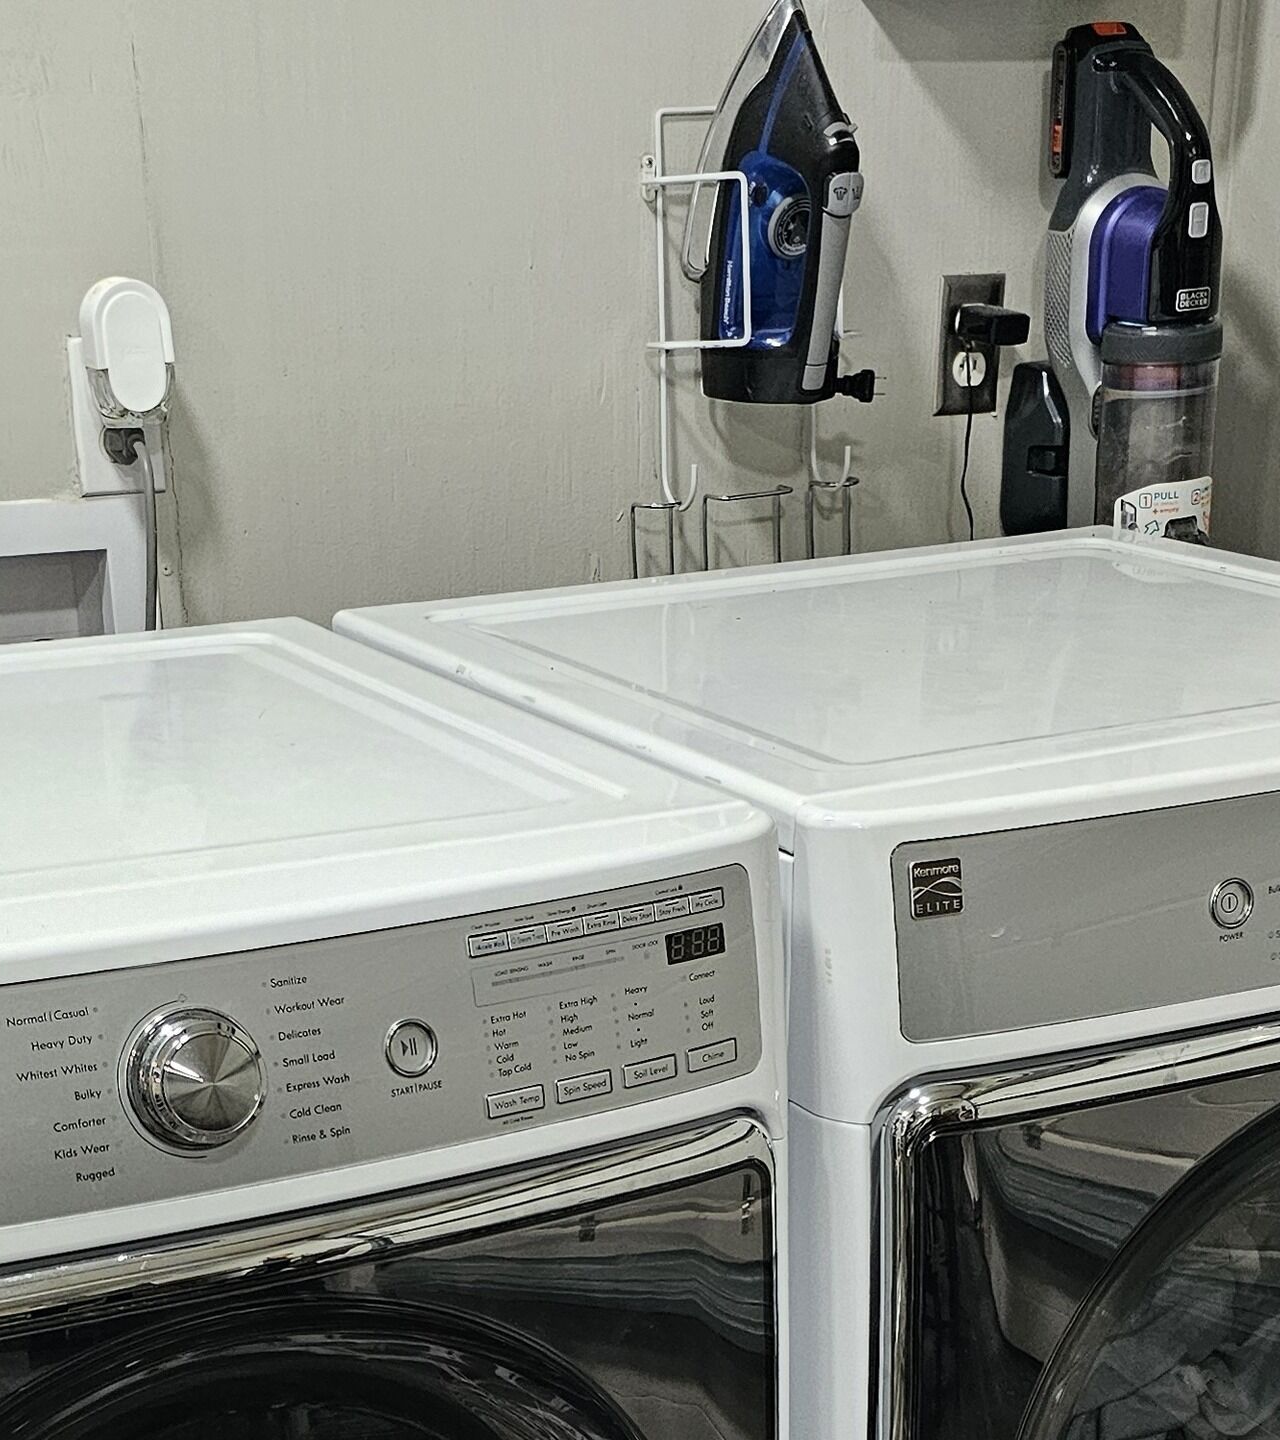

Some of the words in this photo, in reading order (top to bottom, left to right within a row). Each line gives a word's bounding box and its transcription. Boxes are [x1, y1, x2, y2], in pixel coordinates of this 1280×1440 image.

[1179, 298, 1207, 308] DECKER
[1153, 491, 1179, 501] PULL
[913, 865, 959, 878] Kenmore
[915, 899, 960, 914] ELITE
[563, 925, 580, 935] Wash
[1219, 931, 1244, 943] POWER
[269, 975, 309, 989] Sanitize
[688, 970, 716, 982] Connect
[624, 985, 648, 996] Heavy
[274, 1000, 317, 1015] Workout
[317, 996, 346, 1008] Wear
[559, 1000, 579, 1010] Extra
[580, 994, 598, 1006] High
[698, 994, 715, 1006] Loud
[490, 1014, 511, 1024] Extra
[512, 1010, 526, 1020] Hot
[560, 1013, 579, 1024] High
[627, 1008, 655, 1021] Normal
[700, 1008, 714, 1019] Soft
[562, 1024, 593, 1036] Medium
[701, 1021, 714, 1031] Off
[278, 1026, 323, 1042] Delicates
[492, 1028, 506, 1038] Hot
[31, 1039, 66, 1052] Heavy
[68, 1035, 94, 1046] Duty
[494, 1040, 520, 1051] Warm
[563, 1041, 578, 1050] Low
[630, 1037, 648, 1048] Light
[282, 1055, 311, 1069] Small
[312, 1050, 337, 1063] Load
[496, 1053, 514, 1064] Cold
[565, 1053, 577, 1062] No
[578, 1049, 595, 1060] Spin
[701, 1051, 725, 1062] Chime
[15, 1068, 59, 1083] Whitest
[61, 1062, 99, 1076] Whites
[514, 1062, 532, 1073] Cold
[633, 1070, 648, 1080] Soil
[649, 1064, 669, 1076] Level
[286, 1080, 322, 1094] Express
[322, 1073, 351, 1087] Wash
[563, 1085, 581, 1096] Spin
[582, 1078, 608, 1092] Speed
[74, 1089, 103, 1102] Bulky
[494, 1100, 517, 1110] Wash
[519, 1094, 540, 1105] Temp
[289, 1105, 312, 1120] Cold
[313, 1102, 343, 1116] Clean
[53, 1117, 108, 1134] Comforter
[291, 1133, 317, 1145] Rinse
[319, 1129, 328, 1140] &
[329, 1126, 352, 1140] Spin
[54, 1148, 79, 1161] Kids
[80, 1144, 111, 1157] Wear
[76, 1167, 117, 1183] Rugged
